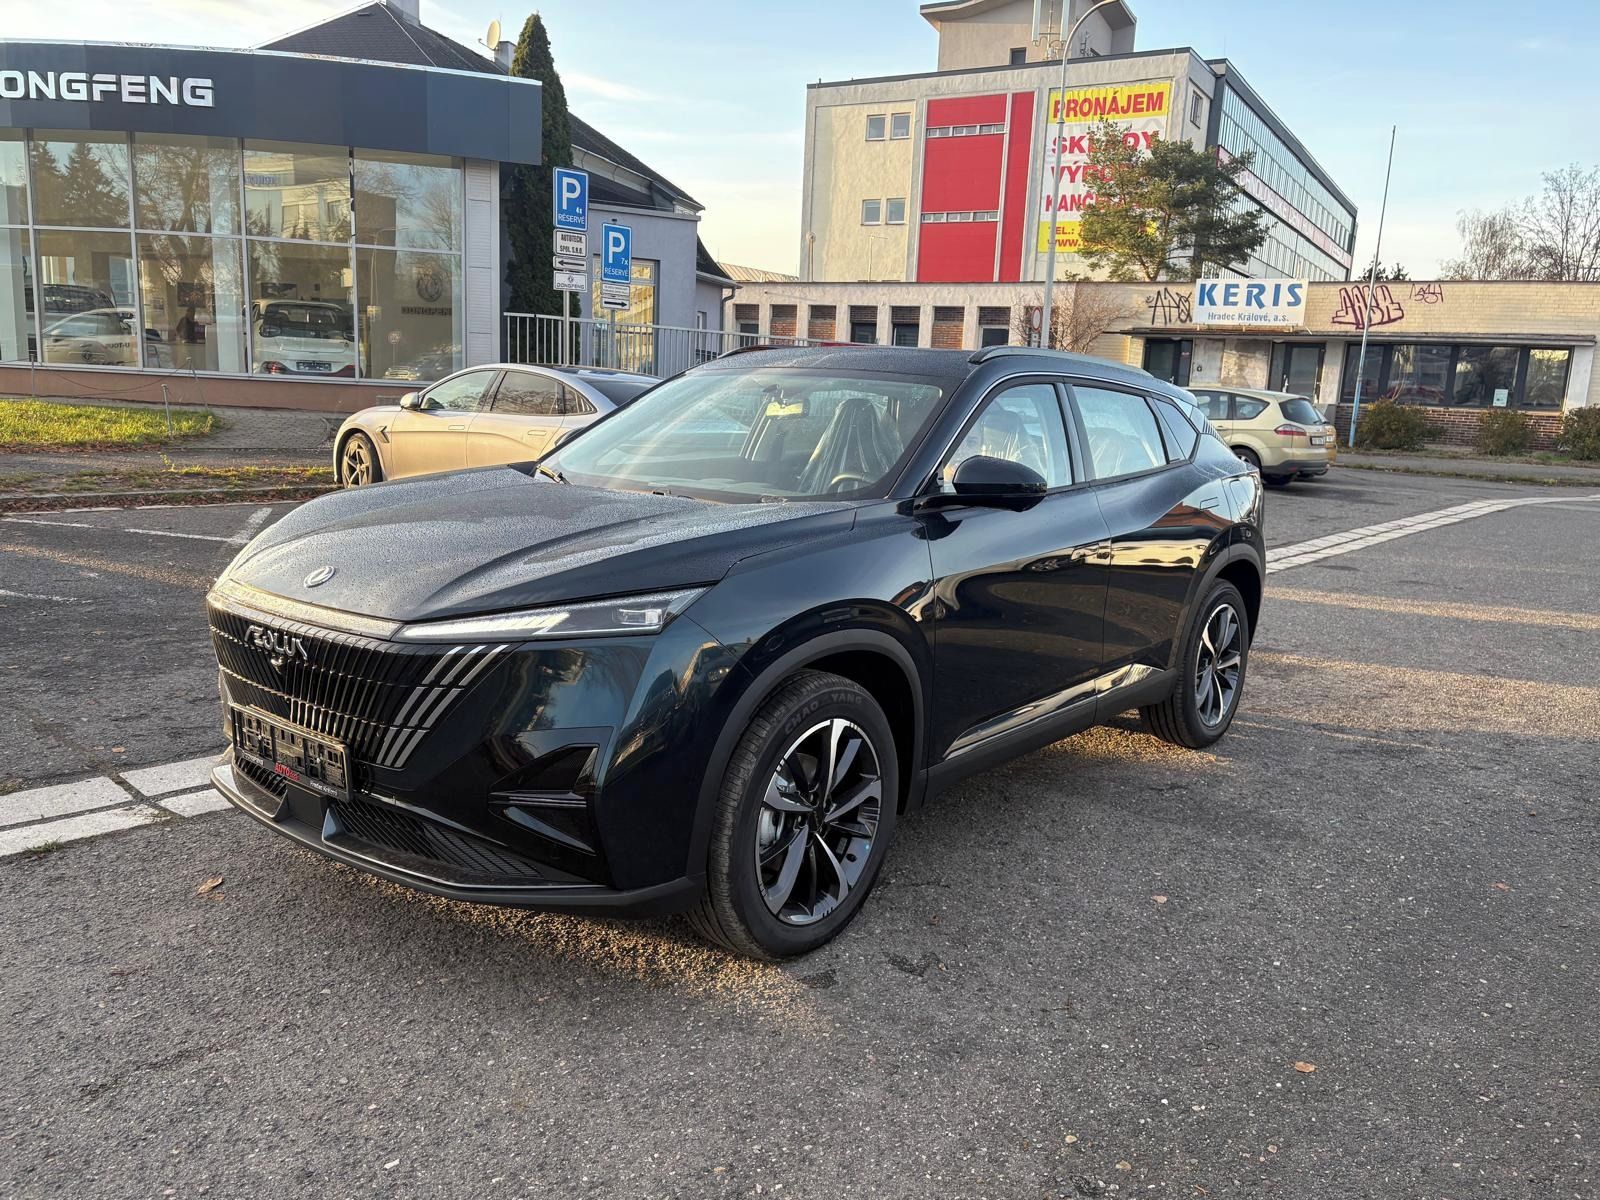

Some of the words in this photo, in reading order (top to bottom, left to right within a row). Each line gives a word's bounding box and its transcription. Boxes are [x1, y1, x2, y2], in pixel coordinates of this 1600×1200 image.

[0, 70, 214, 107] ONGFENG
[1053, 91, 1164, 118] PRONÁJEM
[1052, 131, 1159, 155] SKDY
[562, 177, 581, 210] P
[1048, 227, 1075, 235] EL.:
[608, 231, 626, 264] P
[621, 258, 629, 266] 7x
[556, 282, 585, 290] DONGFENG
[1198, 283, 1303, 310] KERIS
[1207, 312, 1235, 321] Hradec
[1273, 314, 1289, 322] a.s.
[831, 693, 862, 704] YANG
